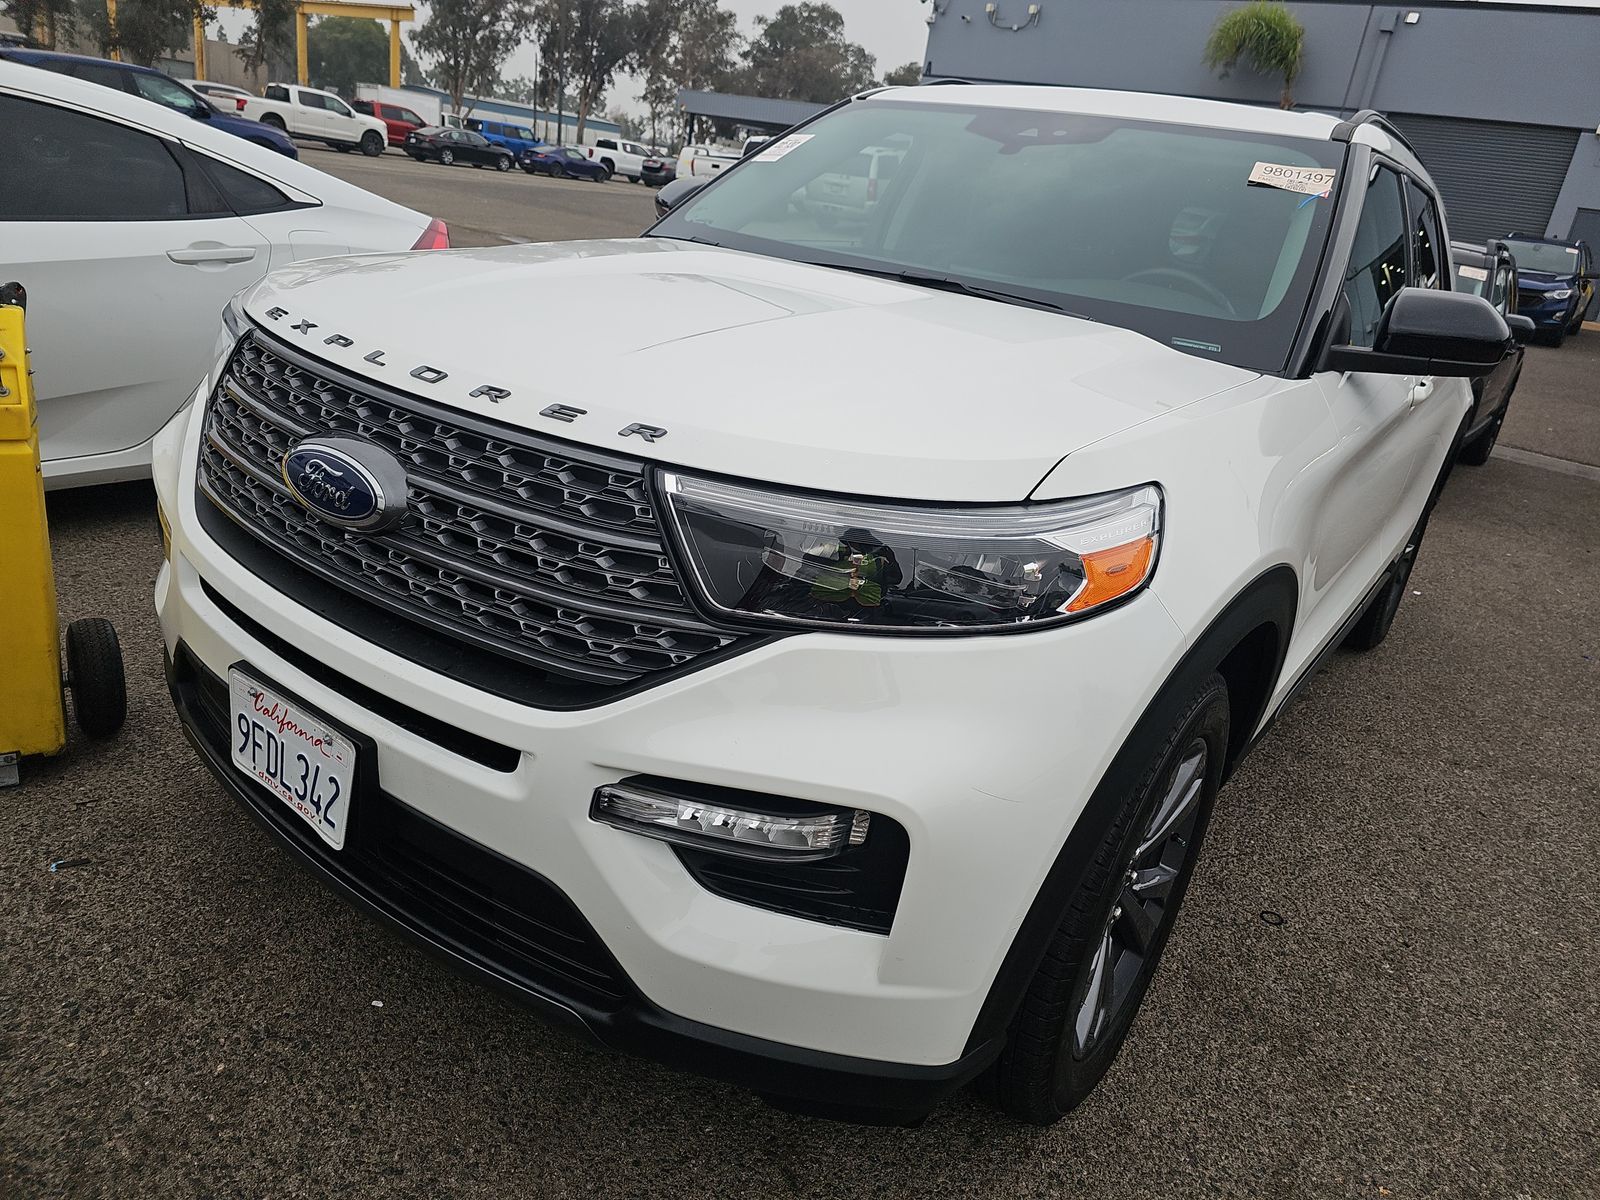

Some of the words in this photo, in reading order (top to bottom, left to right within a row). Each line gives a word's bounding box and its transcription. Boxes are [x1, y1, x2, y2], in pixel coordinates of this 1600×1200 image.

[1263, 166, 1335, 184] 9801497
[265, 306, 668, 443] EXPLORER
[298, 459, 355, 511] Ford
[253, 692, 331, 758] California
[238, 713, 340, 829] 9FDL342
[258, 770, 316, 820] dmv.ca.gov
